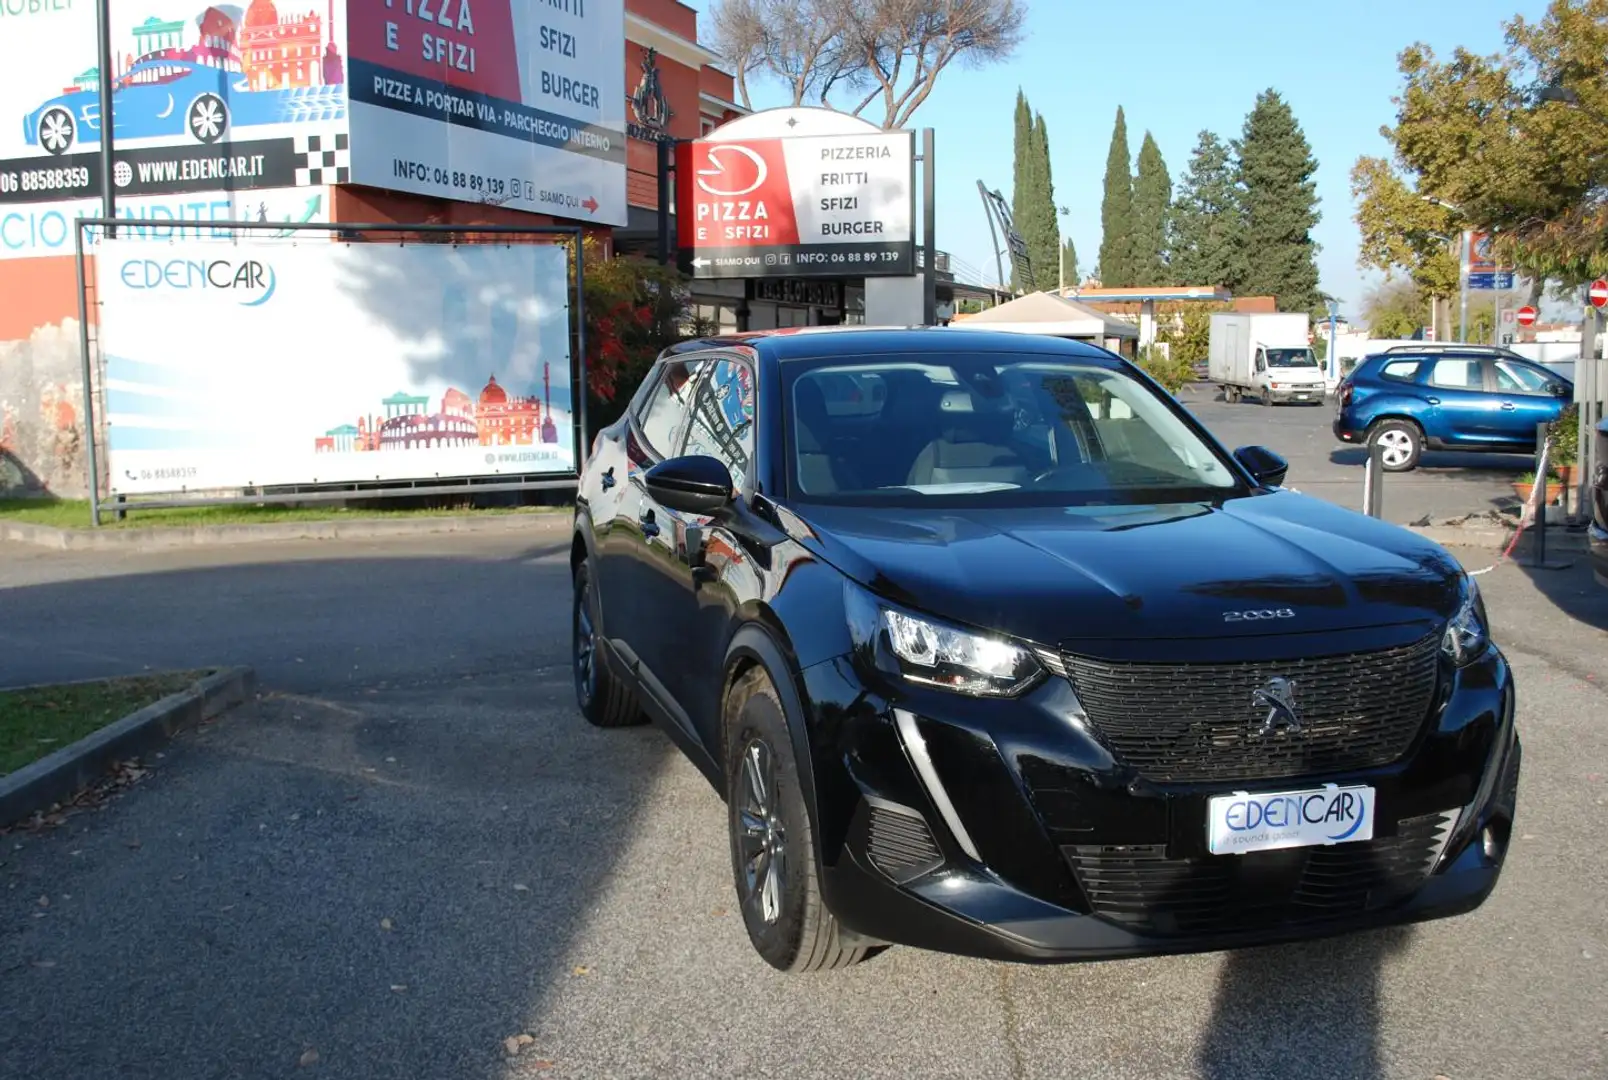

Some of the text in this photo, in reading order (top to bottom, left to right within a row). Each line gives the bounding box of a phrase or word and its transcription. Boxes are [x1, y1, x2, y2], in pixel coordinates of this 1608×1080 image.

[385, 21, 476, 72] E SFIZI
[539, 26, 577, 59] SFIZI
[541, 71, 600, 110] BURGER
[373, 76, 412, 102] PIZZE
[414, 88, 425, 105] A
[426, 90, 475, 118] PORTAR
[476, 105, 497, 124] VIA
[503, 111, 569, 141] PARCHEGGIO
[570, 128, 611, 151] INTERNO
[820, 146, 892, 161] PIZZERIA
[0, 155, 265, 192] 06 88588359 WWW.EDENCAR.IT
[393, 158, 580, 208] INFO: 06 88 89 139 SIAMO QUI
[820, 171, 869, 186] FRITTI
[697, 201, 769, 222] PIZZA
[820, 197, 859, 211] SFIZI
[78, 201, 233, 245] VNDITE
[697, 225, 770, 240] E SFIZI
[820, 220, 884, 236] BURGER
[715, 251, 899, 266] SIAMO QUI INFO: 06 88 89 139
[120, 259, 266, 289] EDENCAR
[1222, 608, 1296, 622] 2008
[1225, 792, 1355, 832] EDENCAR
[1232, 832, 1270, 845] sounds
